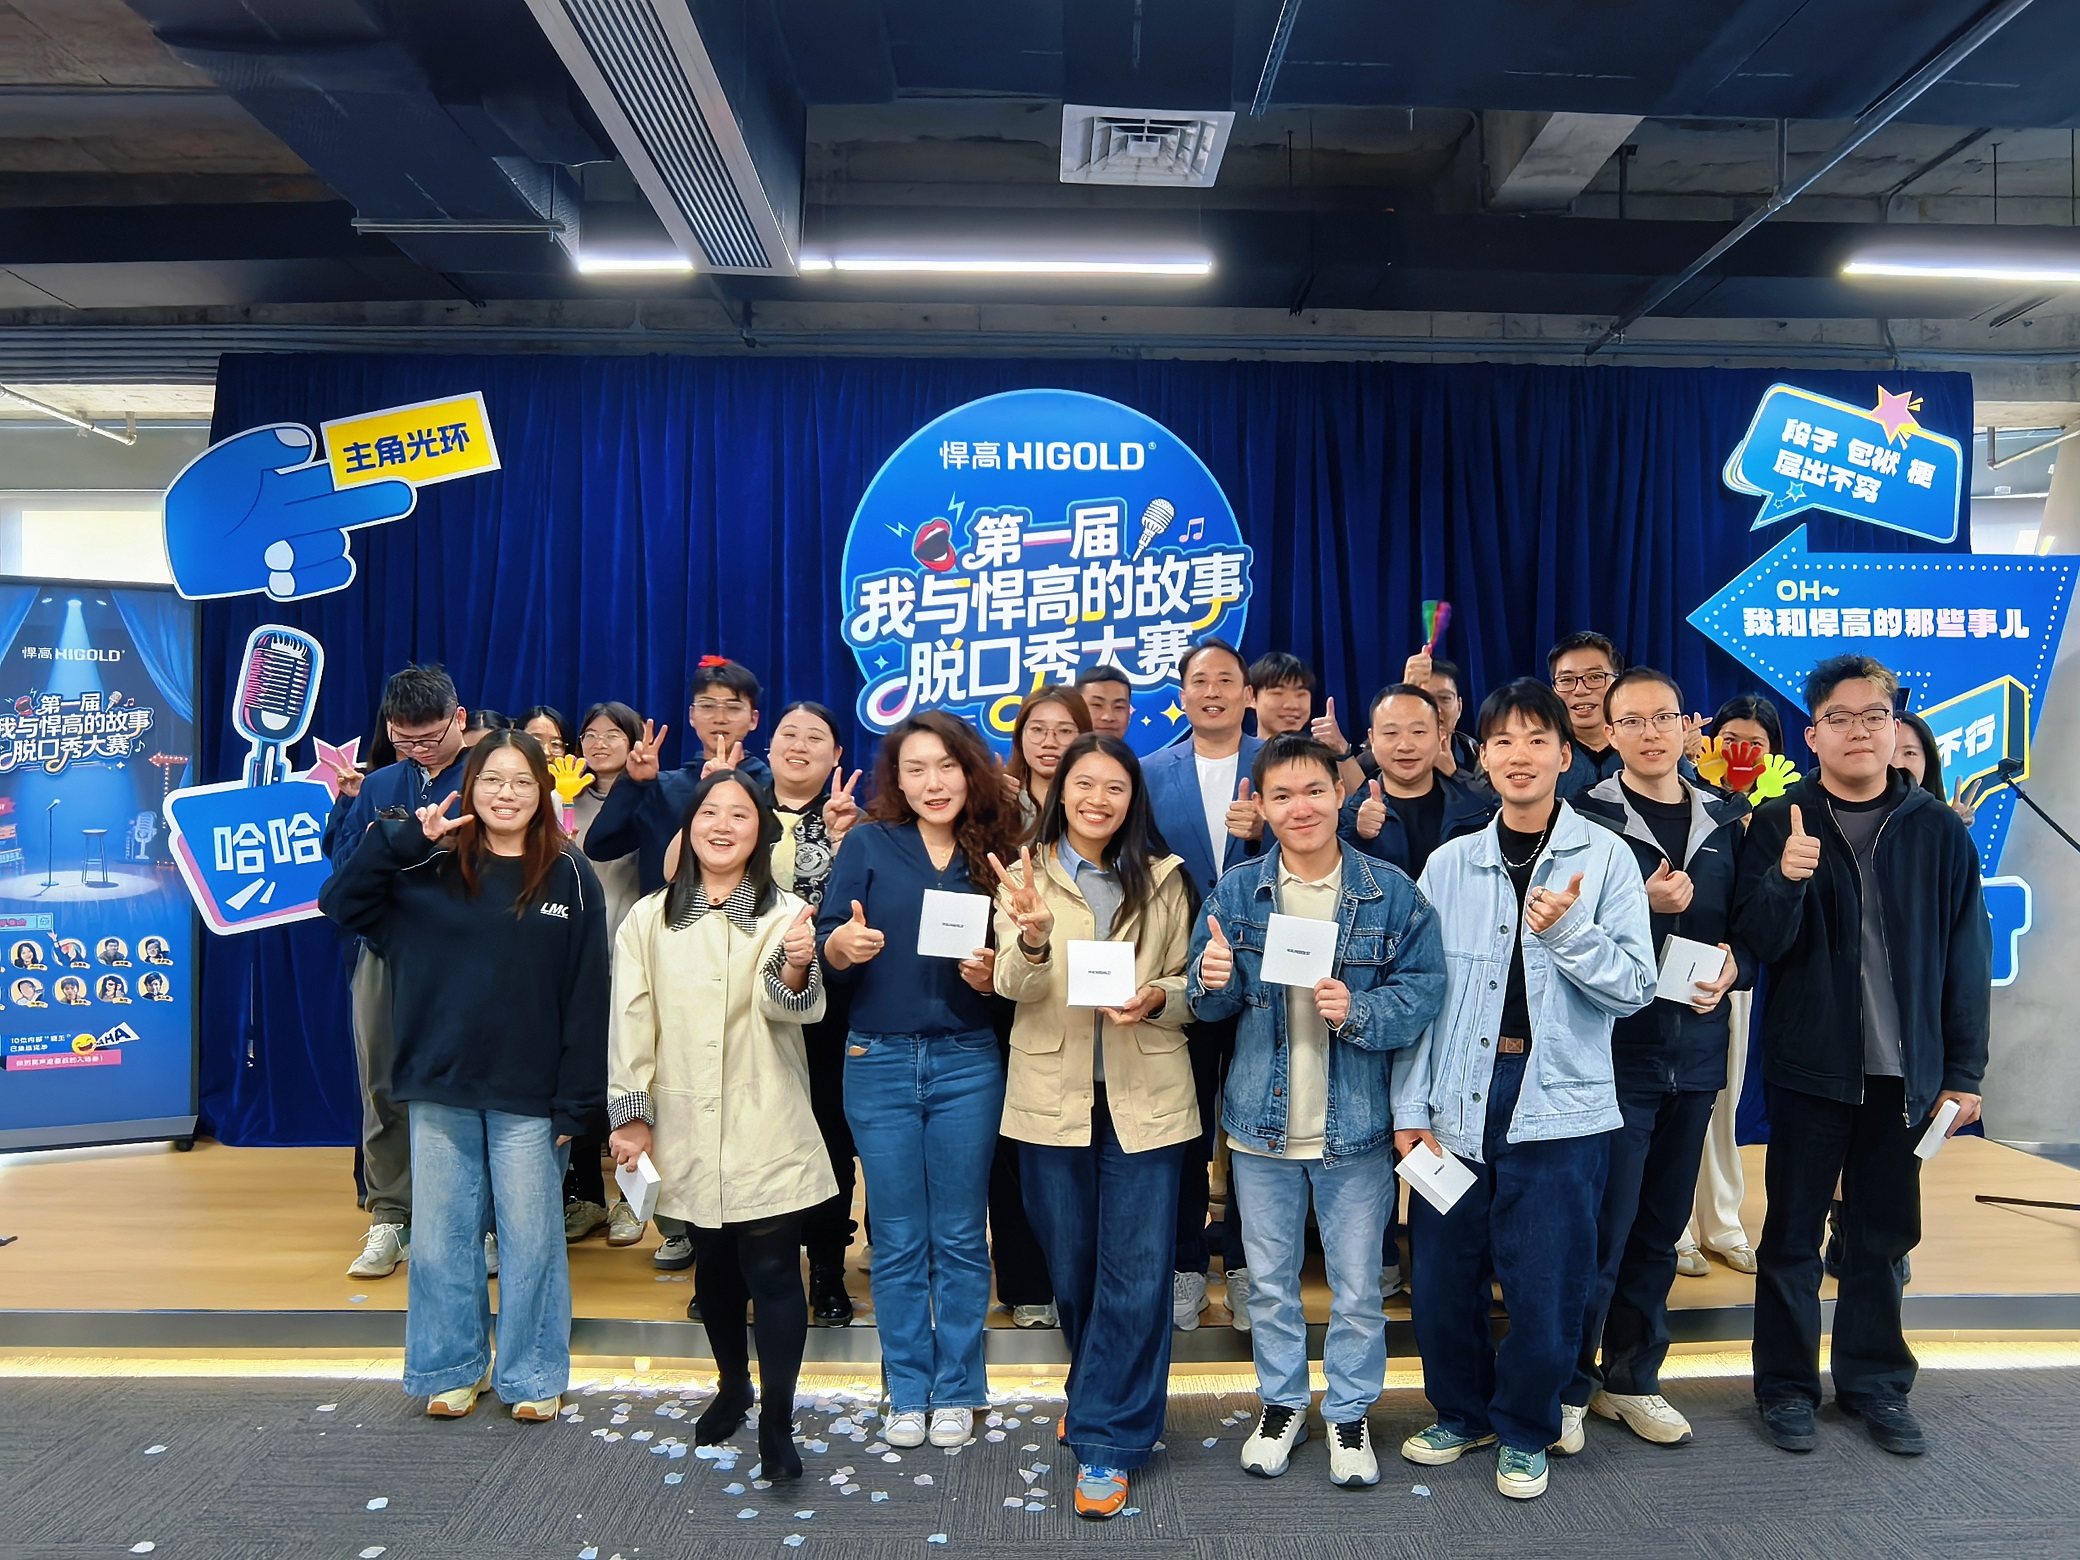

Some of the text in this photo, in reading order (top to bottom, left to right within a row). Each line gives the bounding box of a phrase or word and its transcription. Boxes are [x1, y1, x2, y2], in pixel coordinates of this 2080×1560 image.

[343, 422, 471, 474] 主角光环
[939, 441, 1145, 470] 悍高 HIGOLD
[1781, 418, 1937, 489] 段子 包袱 梗
[1772, 448, 1883, 504] 层出不穷
[962, 505, 1120, 570] 第一届
[851, 551, 1245, 642] 我与悍高的故事
[1776, 580, 1840, 602] OH~
[1742, 607, 2030, 638] 我和悍高的那些事儿
[22, 646, 121, 662] 悍高 HIGOLD
[880, 621, 1193, 718] 脱口秀大赛
[0, 709, 150, 739] 我与悍高的故事
[35, 692, 101, 715] 第一届
[10, 733, 130, 764] 脱口秀大赛
[1935, 713, 1996, 768] 不行
[213, 812, 326, 875] 哈哈
[540, 902, 570, 917] LMC
